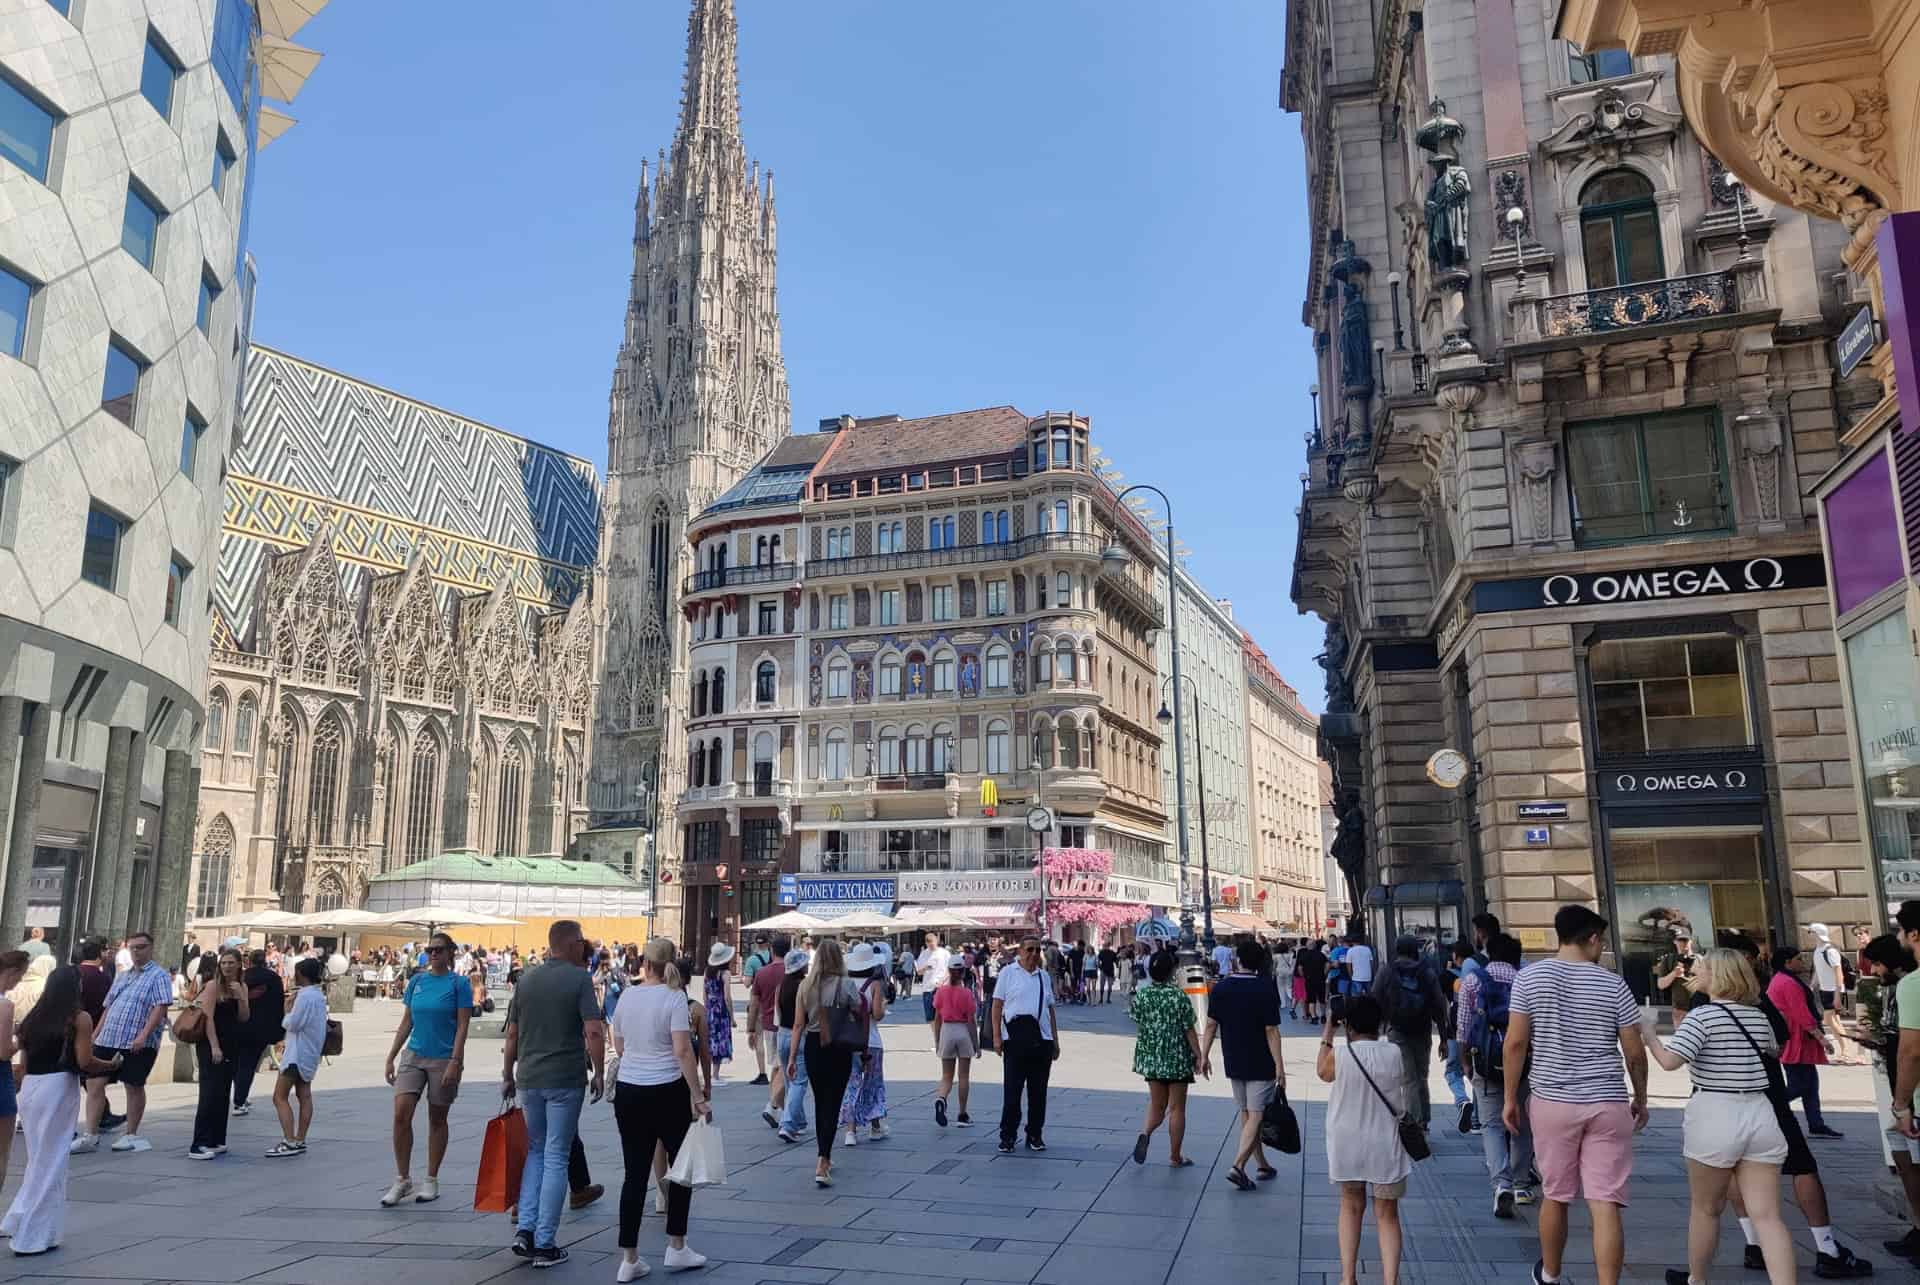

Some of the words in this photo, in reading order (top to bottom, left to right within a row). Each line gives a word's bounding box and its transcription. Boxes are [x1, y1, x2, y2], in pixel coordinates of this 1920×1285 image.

[1592, 566, 1730, 601] OMEGA
[1643, 773, 1718, 791] OMEGA
[798, 883, 836, 899] MONEY
[838, 882, 895, 899] EXCHANGE
